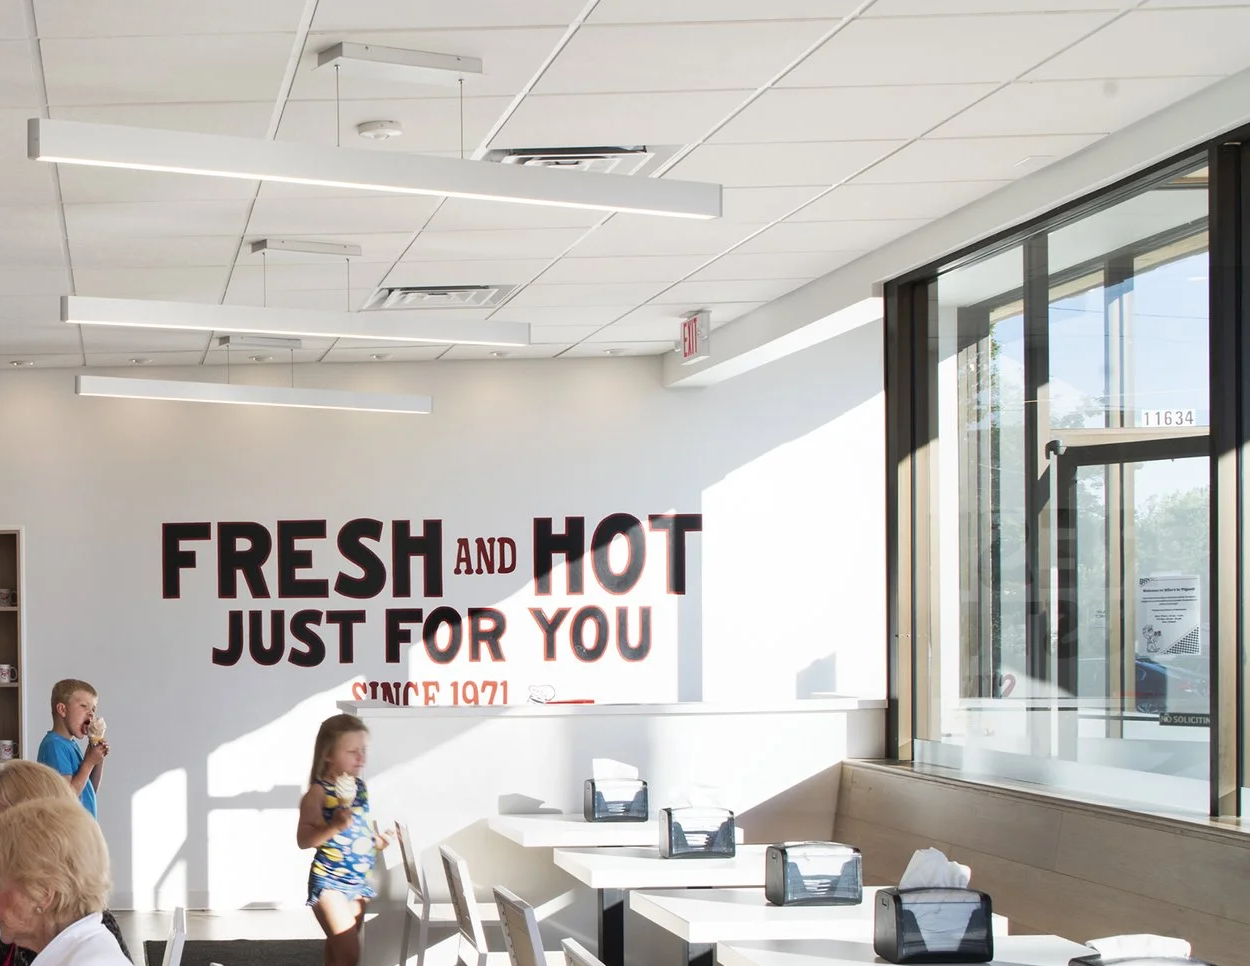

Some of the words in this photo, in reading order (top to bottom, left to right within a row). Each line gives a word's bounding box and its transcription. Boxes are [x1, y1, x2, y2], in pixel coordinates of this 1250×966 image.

[683, 317, 698, 358] EXIT
[1144, 410, 1194, 426] 11634
[161, 517, 444, 600] FRESH
[453, 536, 518, 576] AND
[533, 512, 703, 597] HOT
[212, 609, 366, 668] JUST
[385, 605, 507, 664] FOR
[527, 604, 653, 663] YOU
[351, 679, 441, 706] SINCE
[449, 679, 509, 706] 1971
[1158, 714, 1172, 724] NO
